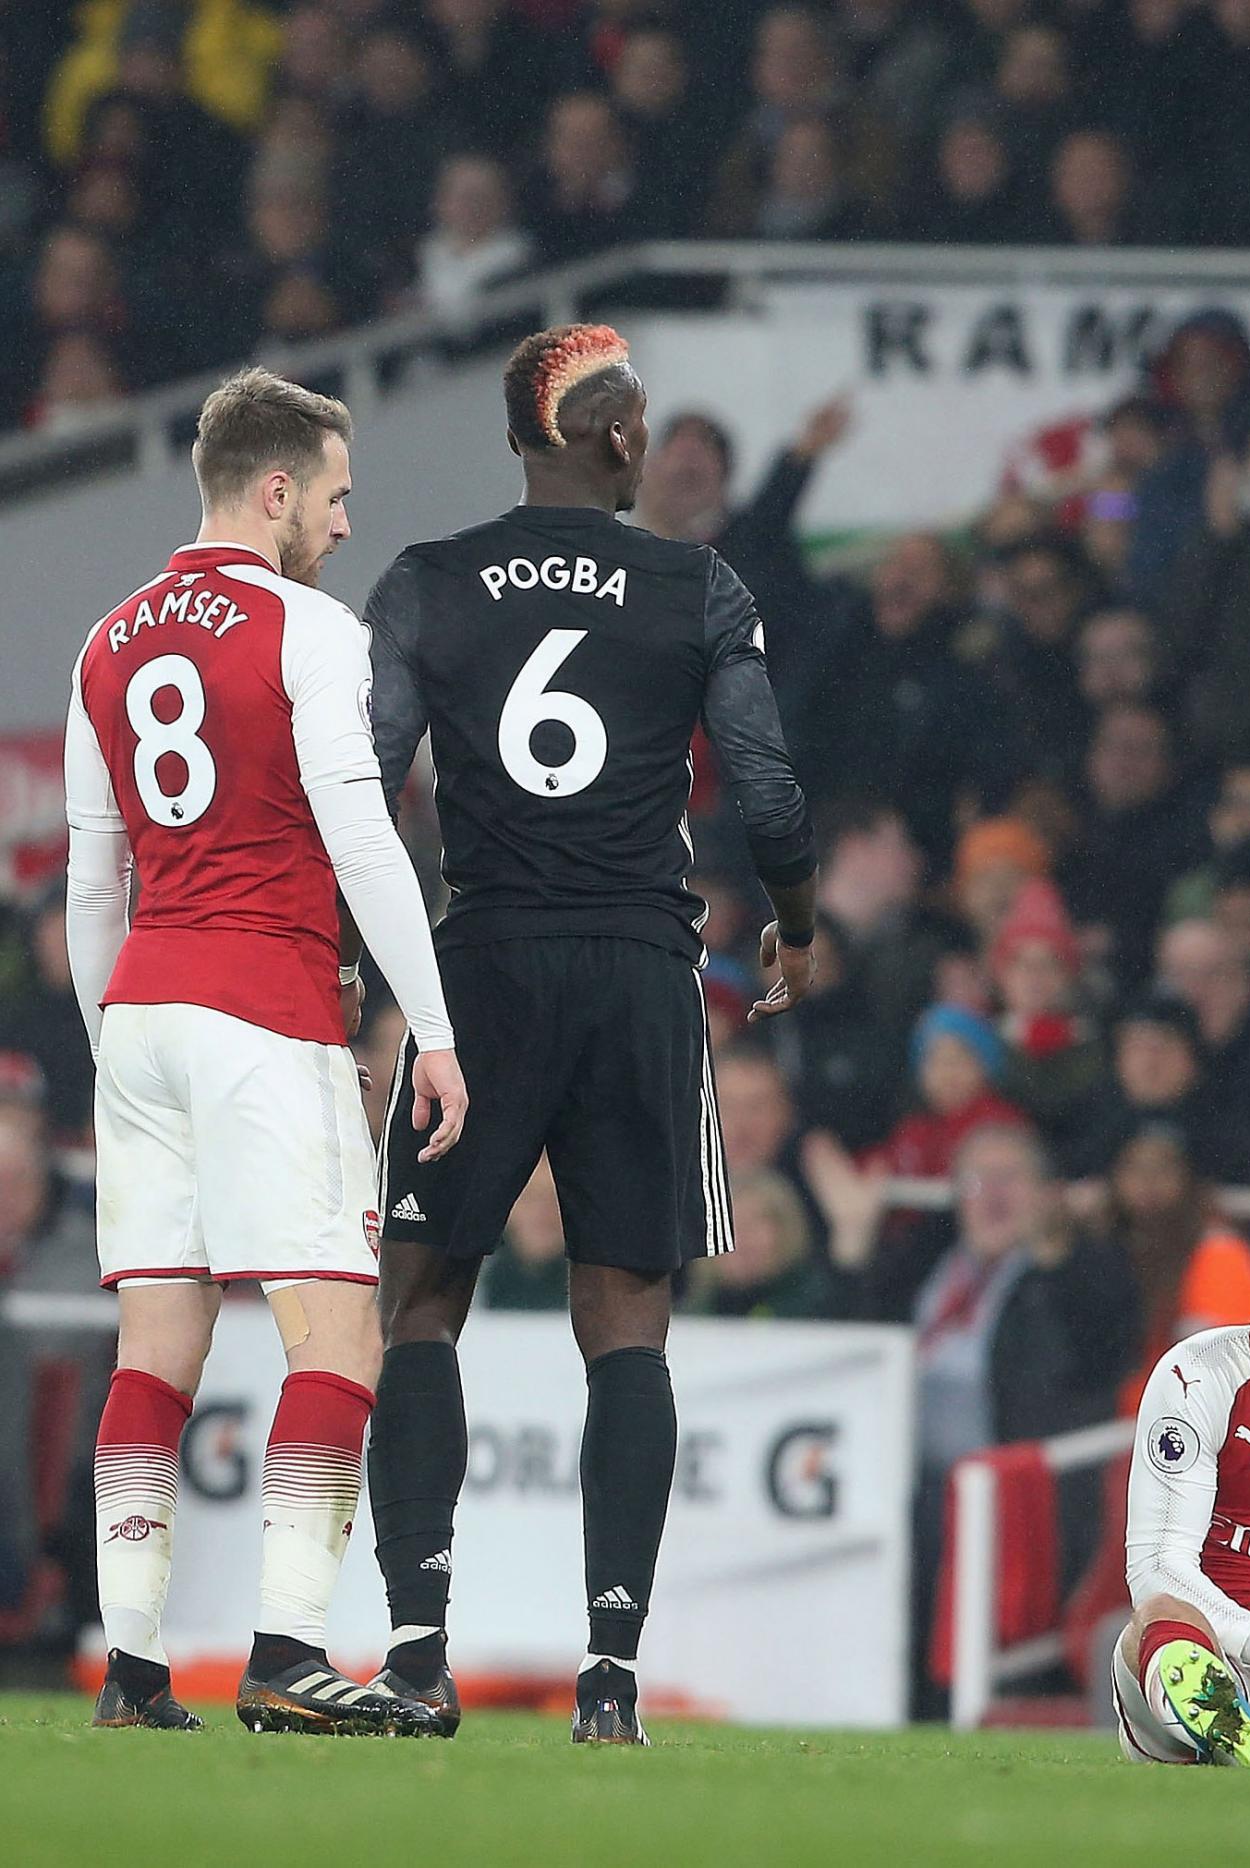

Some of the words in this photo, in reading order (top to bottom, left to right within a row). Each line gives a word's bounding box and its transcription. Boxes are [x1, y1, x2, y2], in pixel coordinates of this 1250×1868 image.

[479, 556, 627, 607] POGBA
[108, 590, 249, 653] RAMSEY
[126, 653, 217, 827] 8
[498, 627, 608, 798] 6
[391, 1208, 427, 1222] adidas
[180, 1402, 252, 1501] G
[763, 1420, 842, 1521] G
[420, 1562, 452, 1575] adid
[592, 1600, 639, 1610] adidas
